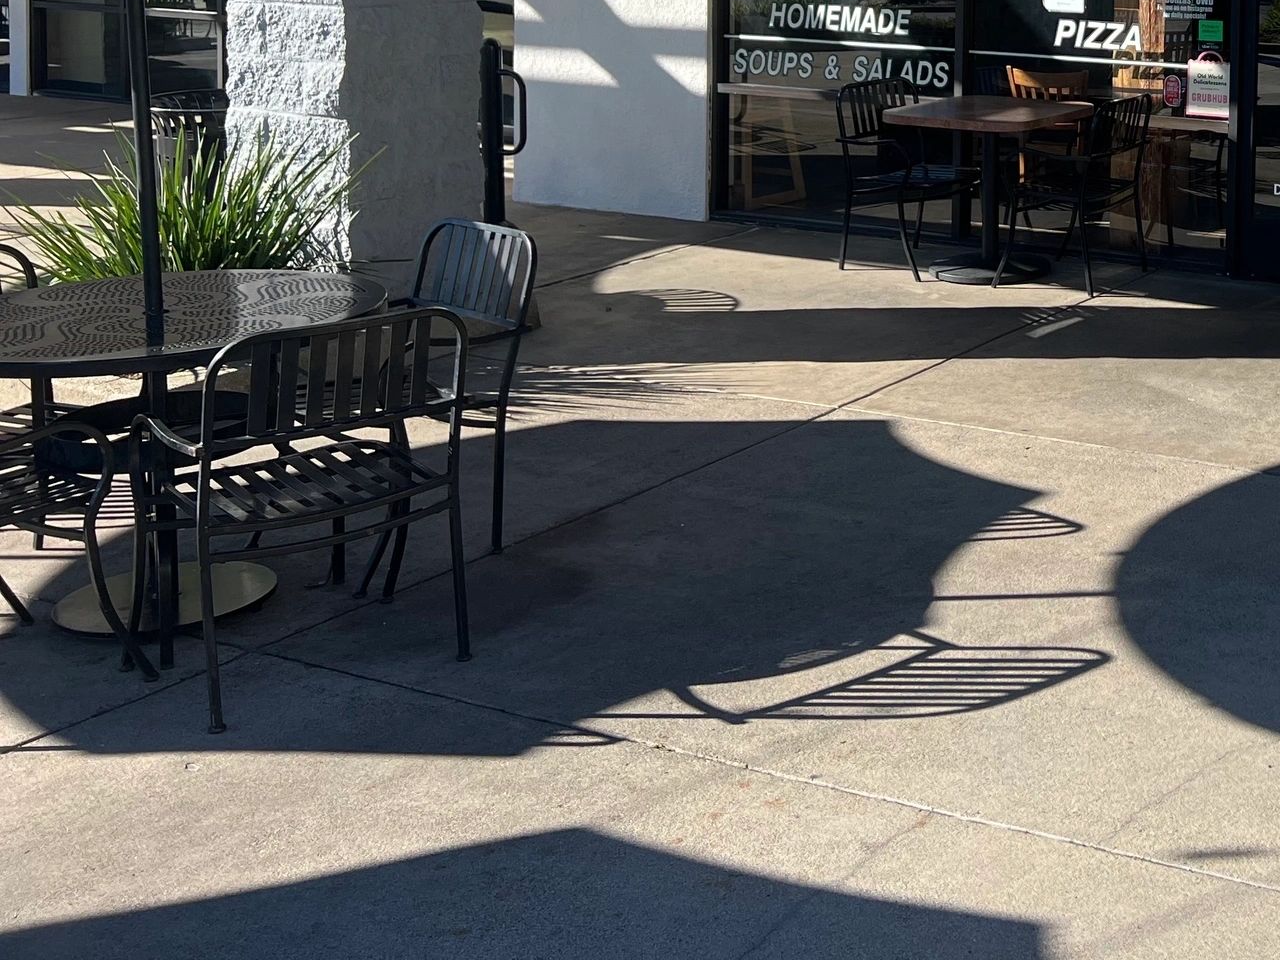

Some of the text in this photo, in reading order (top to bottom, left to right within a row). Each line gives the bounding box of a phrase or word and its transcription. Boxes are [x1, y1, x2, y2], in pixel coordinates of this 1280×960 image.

[769, 2, 912, 36] HOMEMADE
[1053, 18, 1142, 51] PIZZA
[733, 48, 949, 88] SOUPS & SALADS
[1192, 93, 1227, 103] GRUBHUB
